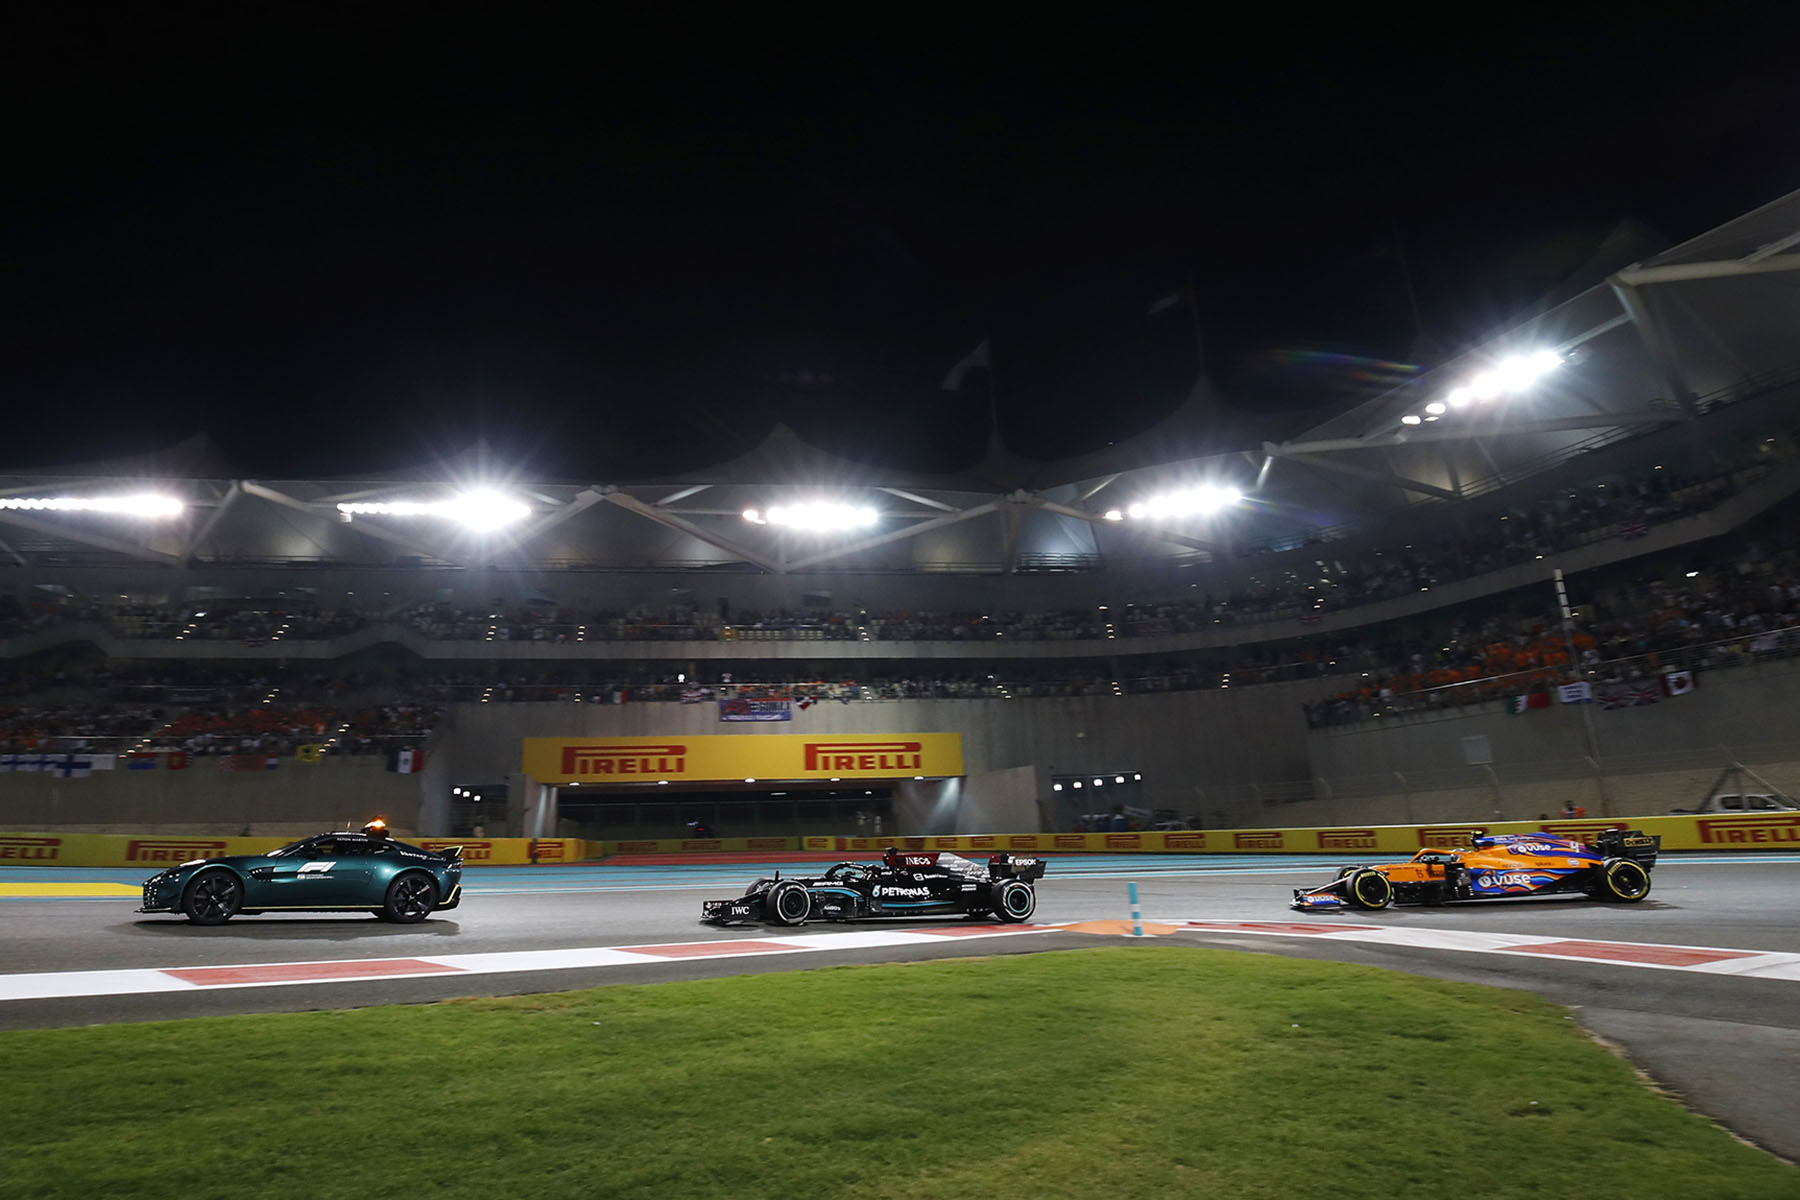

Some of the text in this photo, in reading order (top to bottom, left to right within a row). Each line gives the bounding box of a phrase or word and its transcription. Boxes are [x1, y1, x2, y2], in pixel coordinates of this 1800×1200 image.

[560, 745, 687, 774] PIRELLI
[804, 742, 921, 770] PIRELLI
[1697, 816, 1800, 843] PIRELL
[905, 856, 931, 865] INEOS
[1492, 873, 1532, 886] vuse
[881, 886, 930, 897] PETRONAS
[731, 906, 750, 916] IWC
